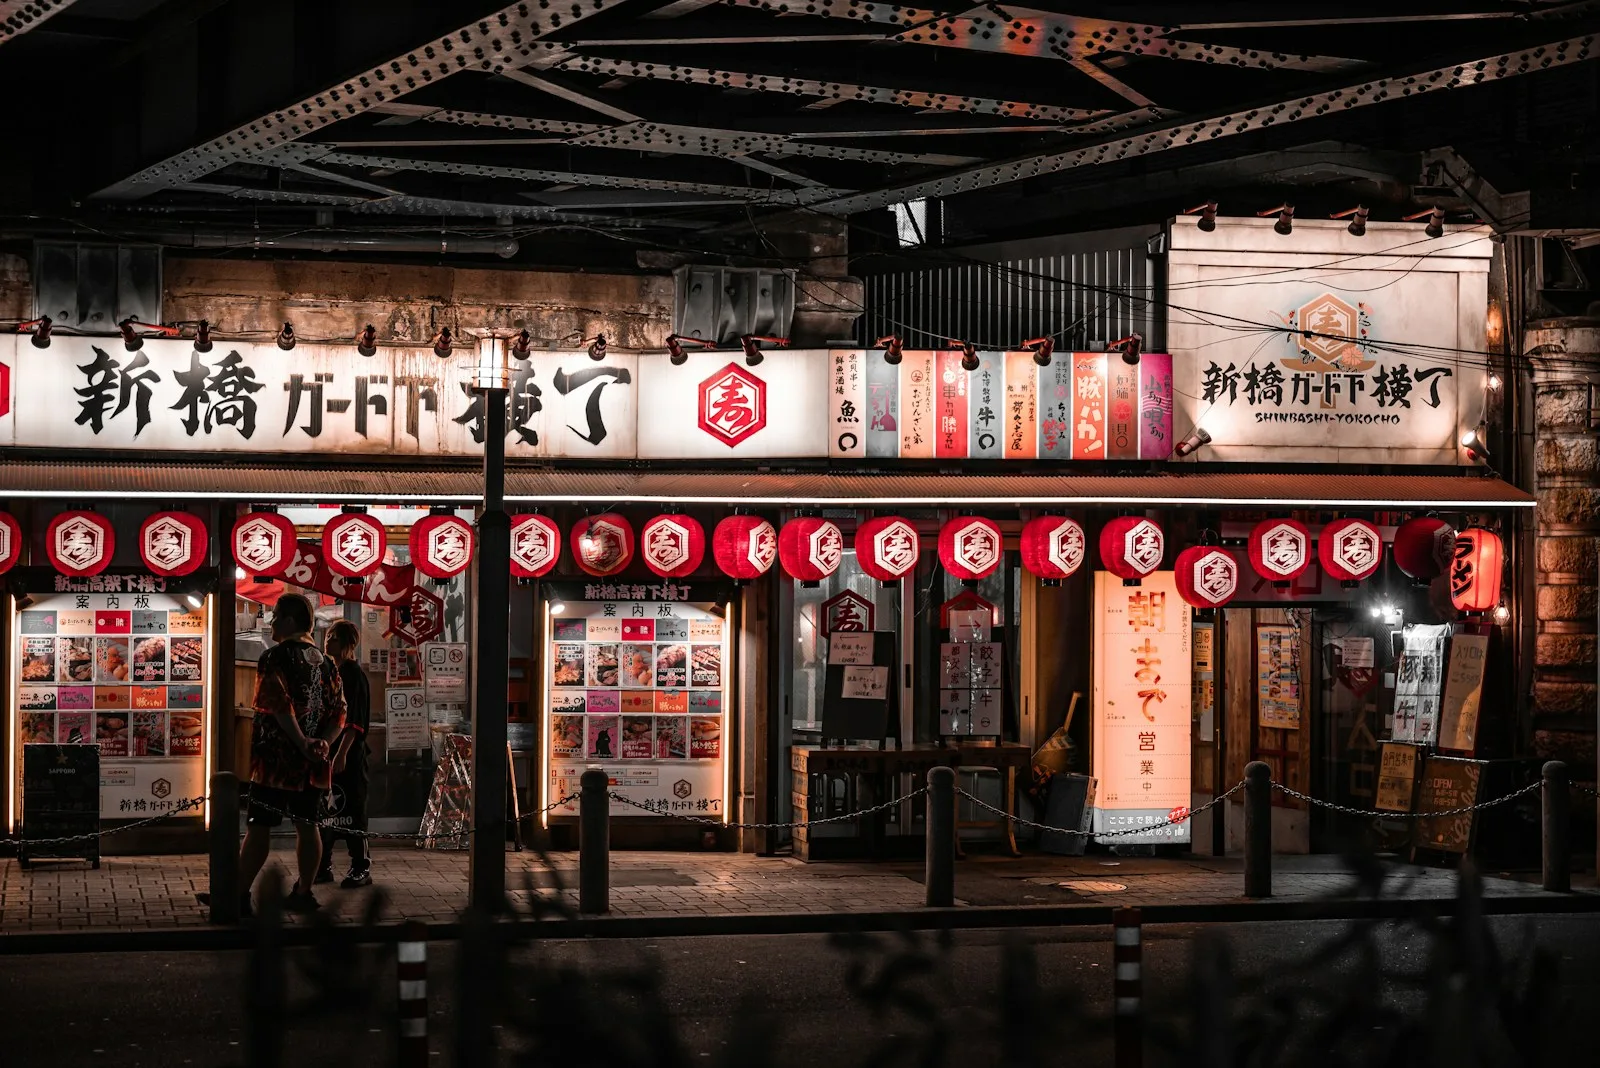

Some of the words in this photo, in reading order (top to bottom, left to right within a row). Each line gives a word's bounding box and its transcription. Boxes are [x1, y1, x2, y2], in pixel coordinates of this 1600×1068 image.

[835, 356, 845, 395] 鮮魚酒場
[1200, 361, 1453, 408] 新橋ガード下横丁
[72, 343, 631, 447] 新橋ガード下横丁
[1255, 412, 1401, 425] SHINBASHI-YOKOCHO
[1453, 537, 1475, 599] ラーメン
[76, 594, 150, 609] 案内板
[585, 584, 691, 600] 新橋高架下横丁
[603, 603, 672, 617] 案内板
[980, 646, 994, 683] 餃子
